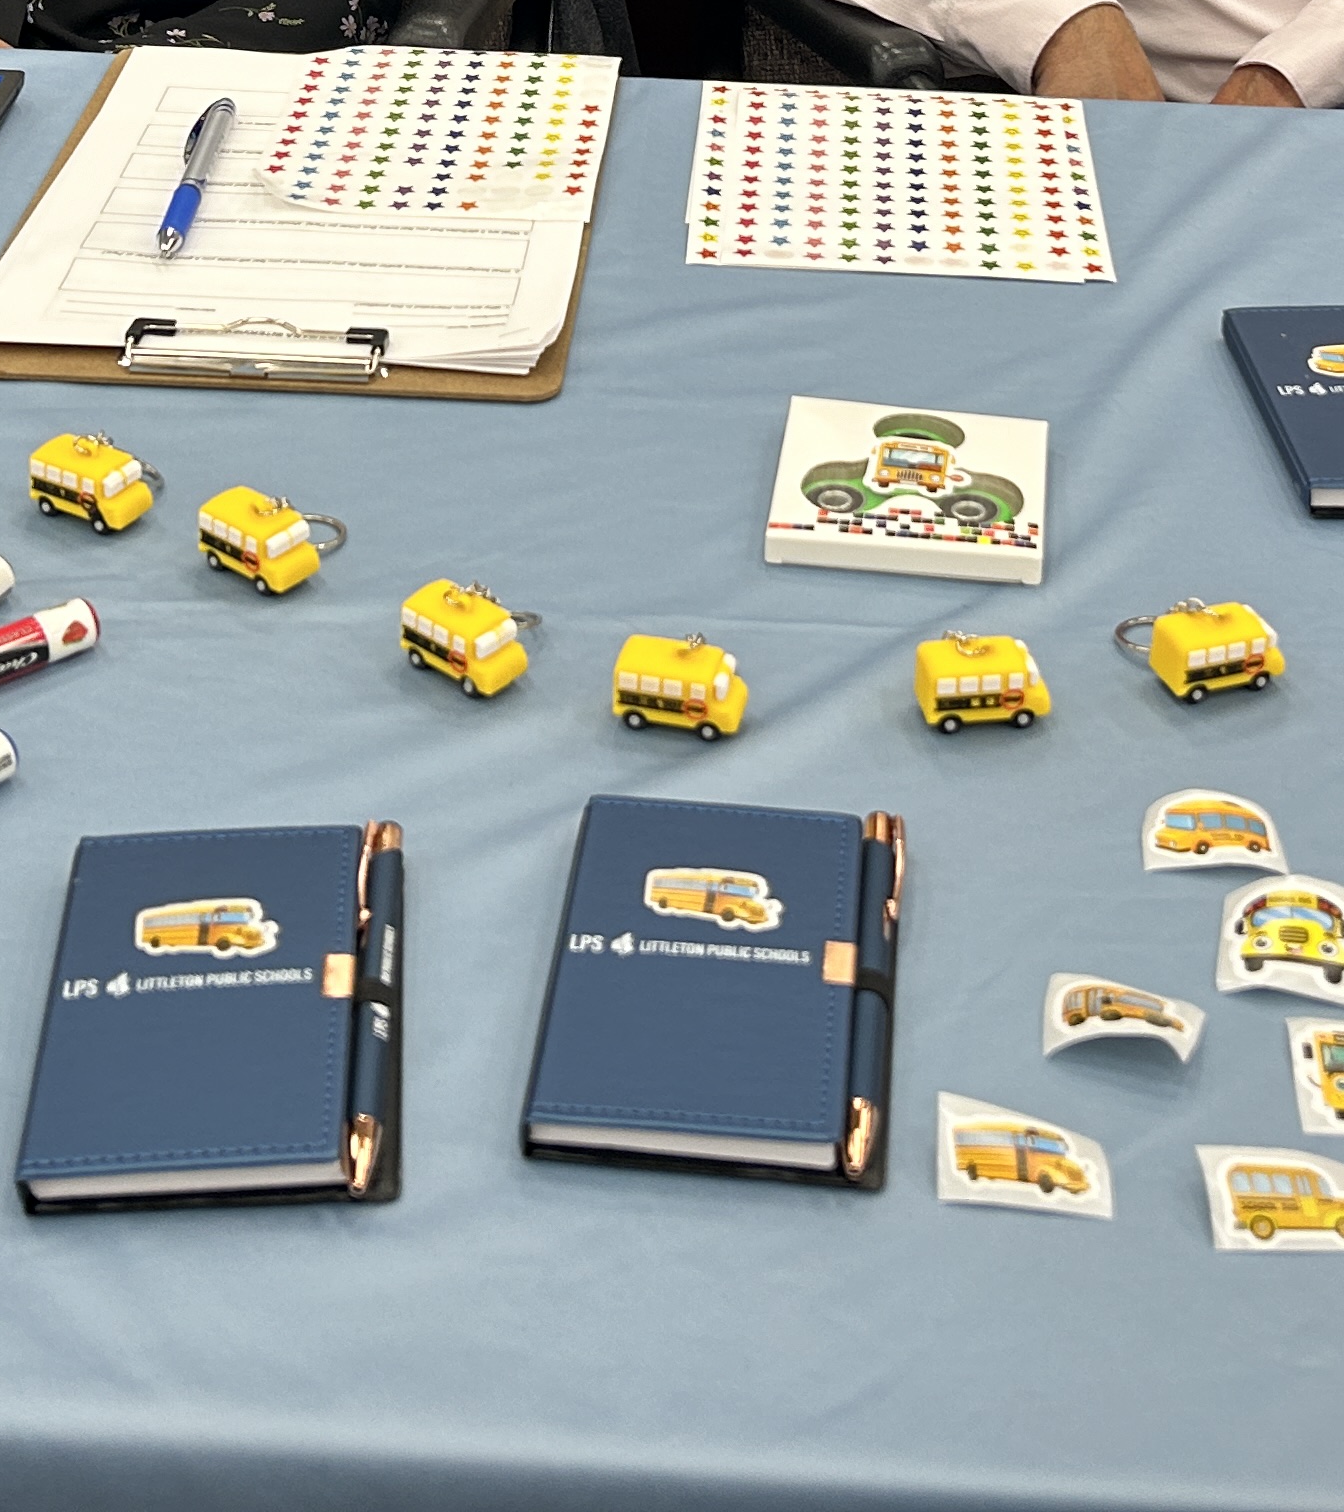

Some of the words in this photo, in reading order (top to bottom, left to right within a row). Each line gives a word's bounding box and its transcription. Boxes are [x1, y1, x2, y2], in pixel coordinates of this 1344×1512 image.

[1276, 385, 1305, 396] LPS
[569, 933, 605, 954] LPS
[639, 939, 705, 958] LITTLETON
[706, 942, 752, 961] PUBLIC
[753, 945, 811, 965] SCHOOLS
[62, 978, 100, 999] LPS
[136, 974, 204, 993] LITTLETON
[206, 970, 253, 988] PUBLIC
[254, 967, 313, 985] SCHOOLS
